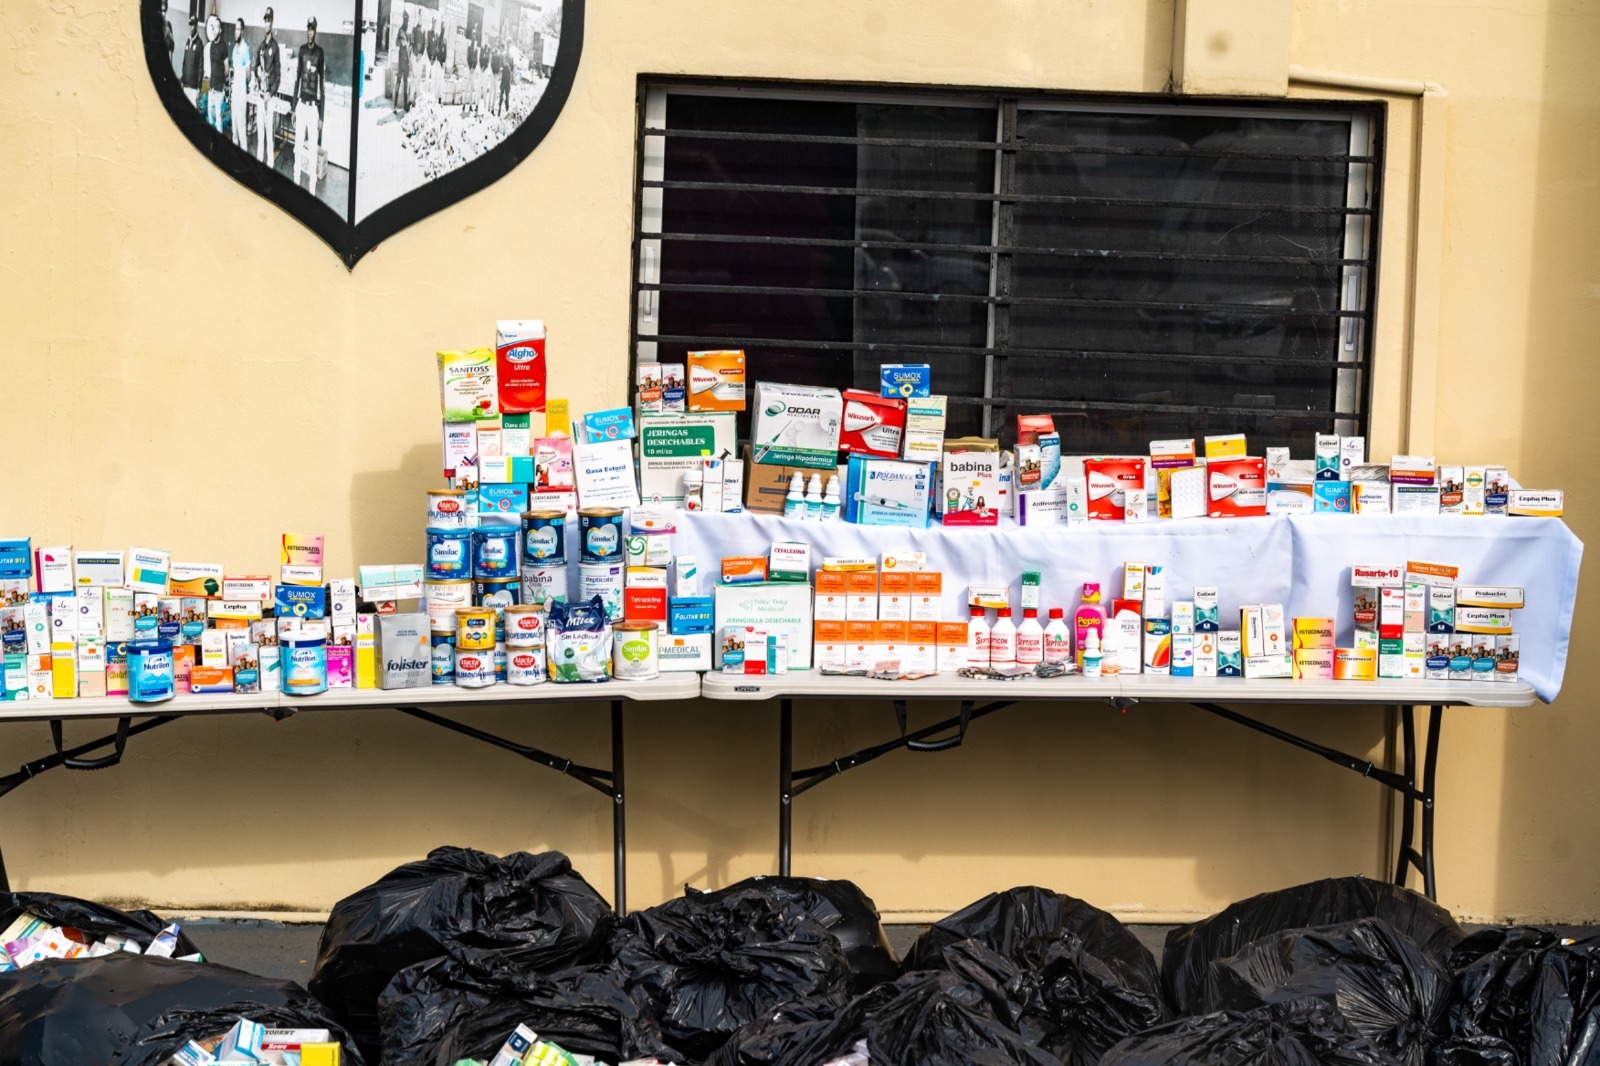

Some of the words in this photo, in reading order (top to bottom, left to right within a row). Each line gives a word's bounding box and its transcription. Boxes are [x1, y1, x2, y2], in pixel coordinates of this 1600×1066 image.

[509, 349, 535, 359] Algho
[787, 406, 820, 414] ODAR
[595, 415, 619, 424] SUMOX
[848, 413, 874, 421] Winasorb
[795, 454, 832, 463] Hipodérmica
[950, 462, 992, 472] babina
[524, 574, 552, 582] babina
[1355, 569, 1398, 578] Rusarte-10
[1078, 617, 1100, 627] Pepto
[144, 662, 169, 670] Nutrilon
[387, 656, 428, 671] folister
